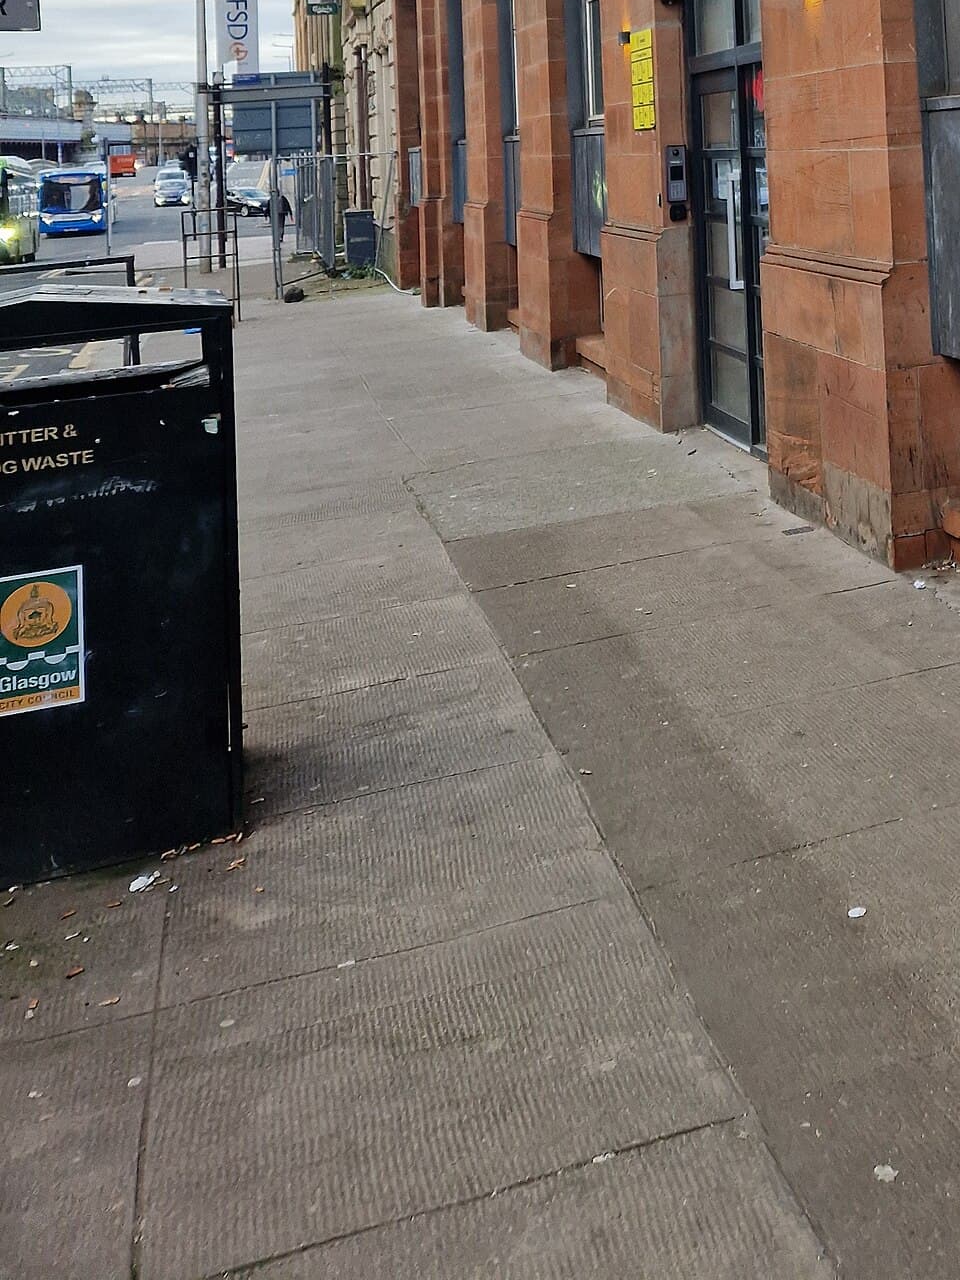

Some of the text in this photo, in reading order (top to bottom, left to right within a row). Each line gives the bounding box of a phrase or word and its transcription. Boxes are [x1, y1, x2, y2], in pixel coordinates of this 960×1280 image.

[63, 423, 78, 438] &
[21, 449, 95, 472] WASTE
[0, 669, 77, 693] Glasgow
